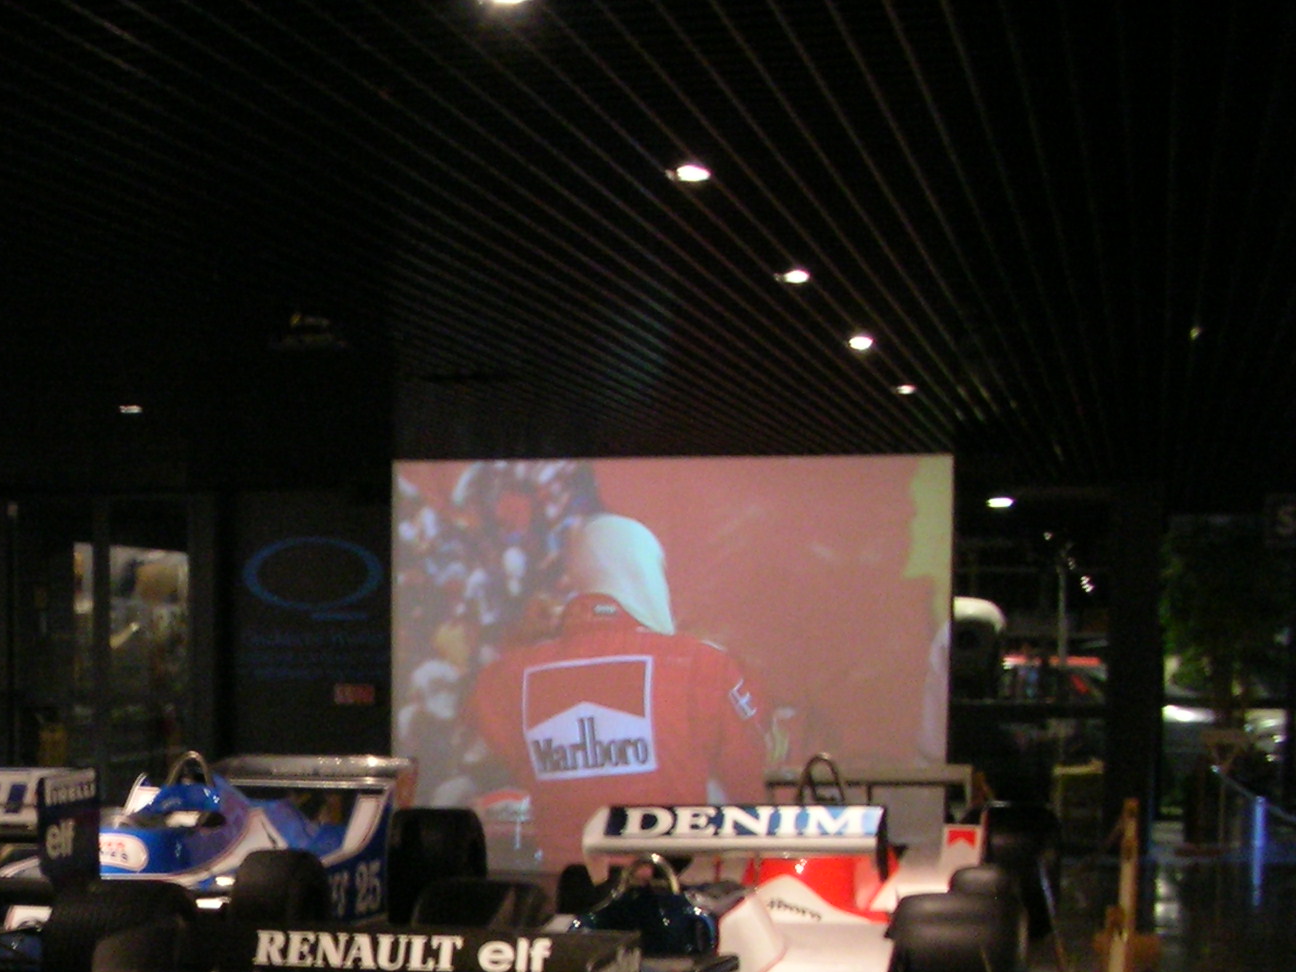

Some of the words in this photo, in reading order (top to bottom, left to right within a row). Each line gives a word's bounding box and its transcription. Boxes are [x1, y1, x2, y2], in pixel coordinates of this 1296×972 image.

[532, 717, 650, 773] Marlboro
[622, 807, 867, 837] DENIM
[253, 929, 462, 972] RENAULT
